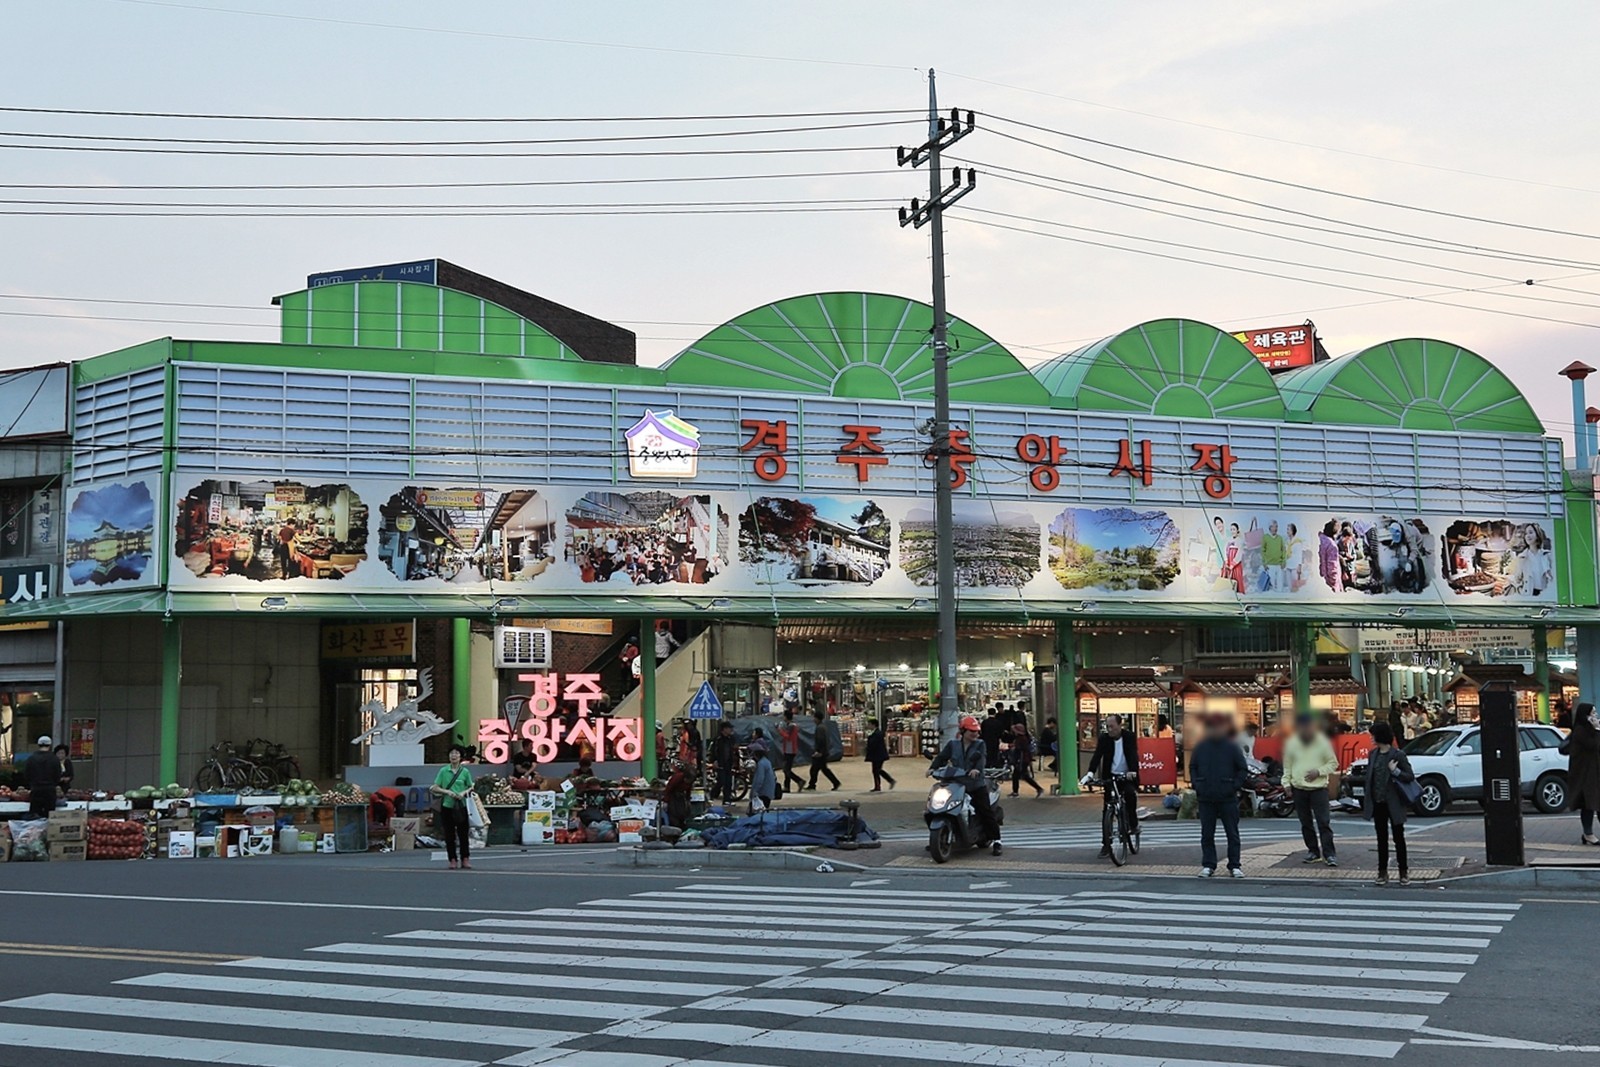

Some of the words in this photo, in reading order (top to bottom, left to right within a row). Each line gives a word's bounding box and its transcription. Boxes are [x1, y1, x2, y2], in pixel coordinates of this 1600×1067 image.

[1253, 329, 1306, 348] 체육관
[0, 572, 48, 605] 사
[327, 626, 409, 654] 화산포목
[518, 673, 602, 717] 경주
[478, 717, 643, 764] 중앙시장
